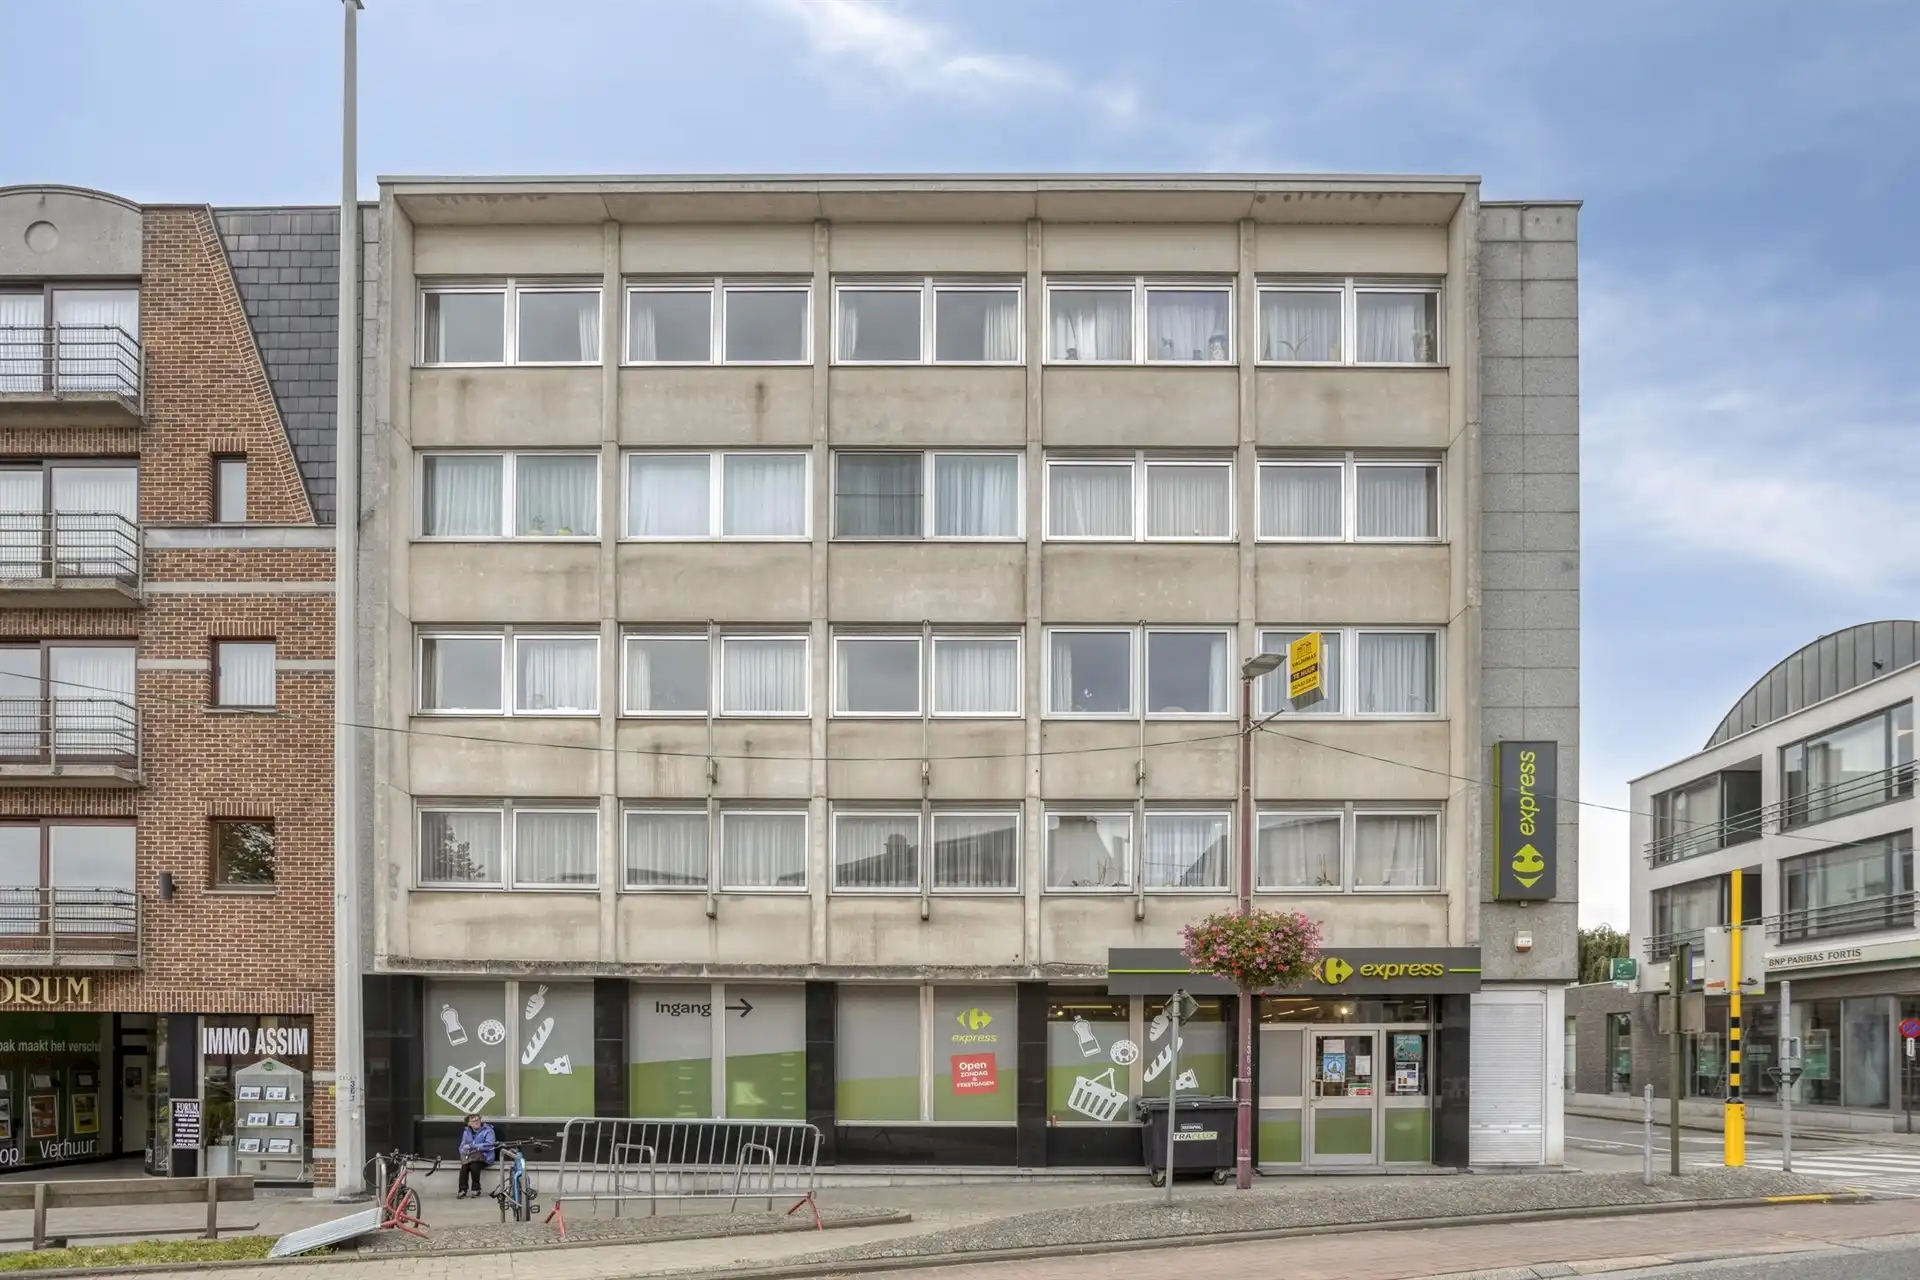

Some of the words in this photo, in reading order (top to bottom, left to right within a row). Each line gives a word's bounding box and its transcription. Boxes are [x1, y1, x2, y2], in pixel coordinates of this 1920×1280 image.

[1520, 750, 1540, 836] express
[1768, 958, 1786, 967] BNP
[1787, 953, 1824, 965] PARIBAS
[1828, 948, 1862, 960] FORTIS
[1360, 963, 1444, 980] express
[655, 1001, 711, 1016] Ingang
[18, 1039, 49, 1052] maakt
[50, 1040, 66, 1052] het
[203, 1027, 250, 1055] IMMO
[254, 1027, 309, 1055] ASSIM
[951, 1034, 998, 1044] express
[959, 1061, 987, 1071] Open
[176, 1102, 198, 1112] FORUM
[40, 1138, 96, 1159] Verhuur
